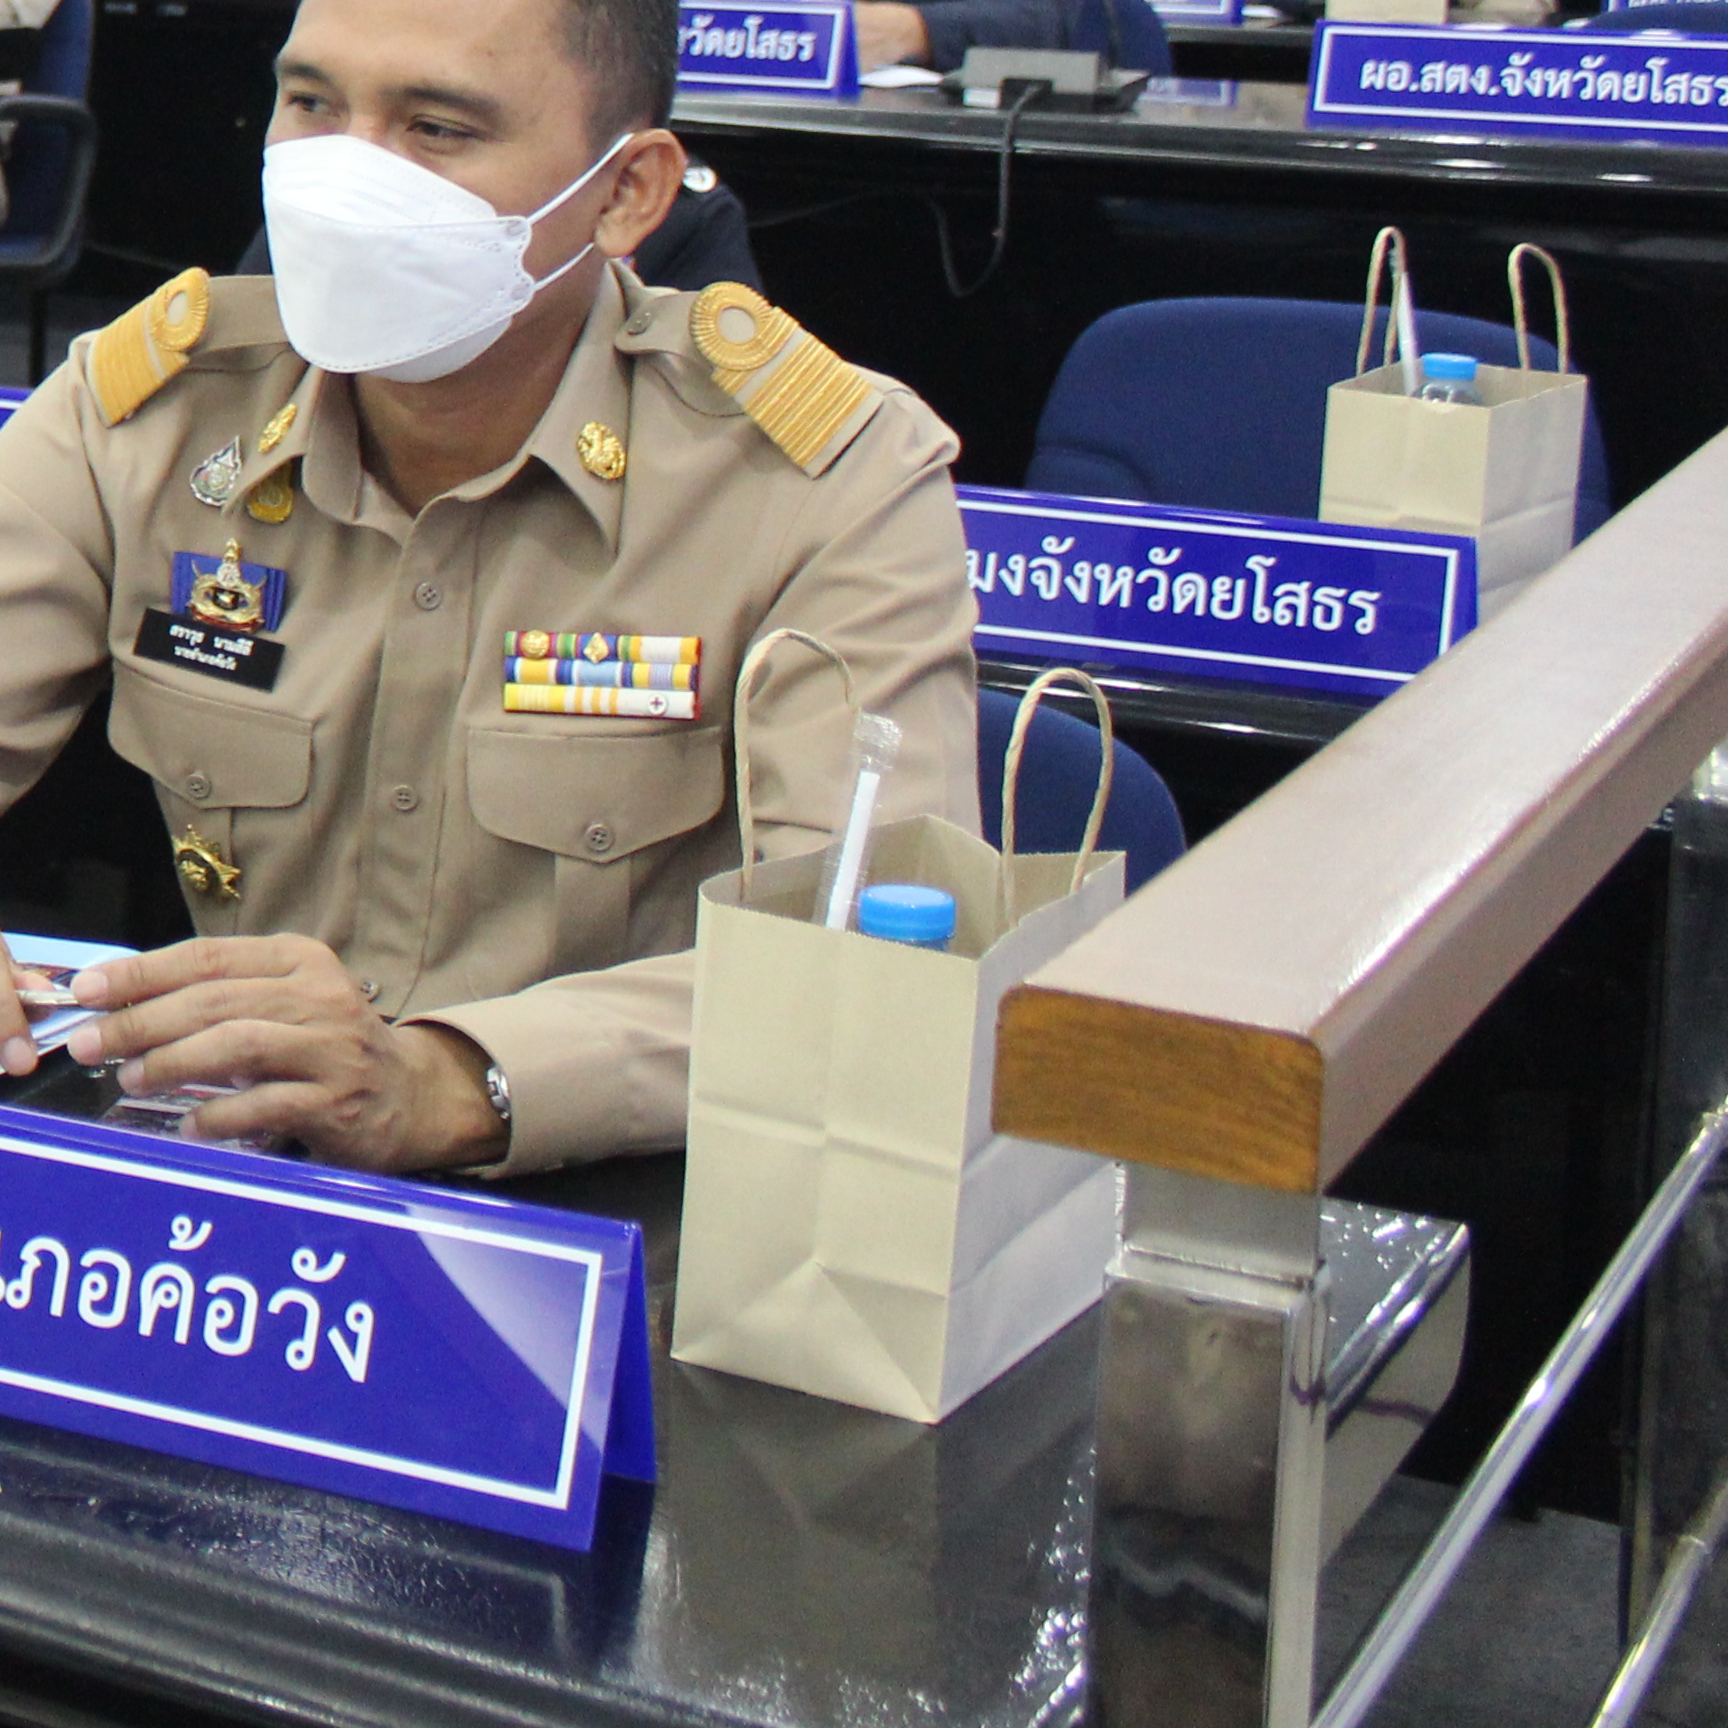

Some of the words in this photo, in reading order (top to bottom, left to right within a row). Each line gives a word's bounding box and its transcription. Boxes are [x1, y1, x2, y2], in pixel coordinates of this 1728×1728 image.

[1359, 51, 1728, 107] ผอ.สตง.จังหวัดยโสธร
